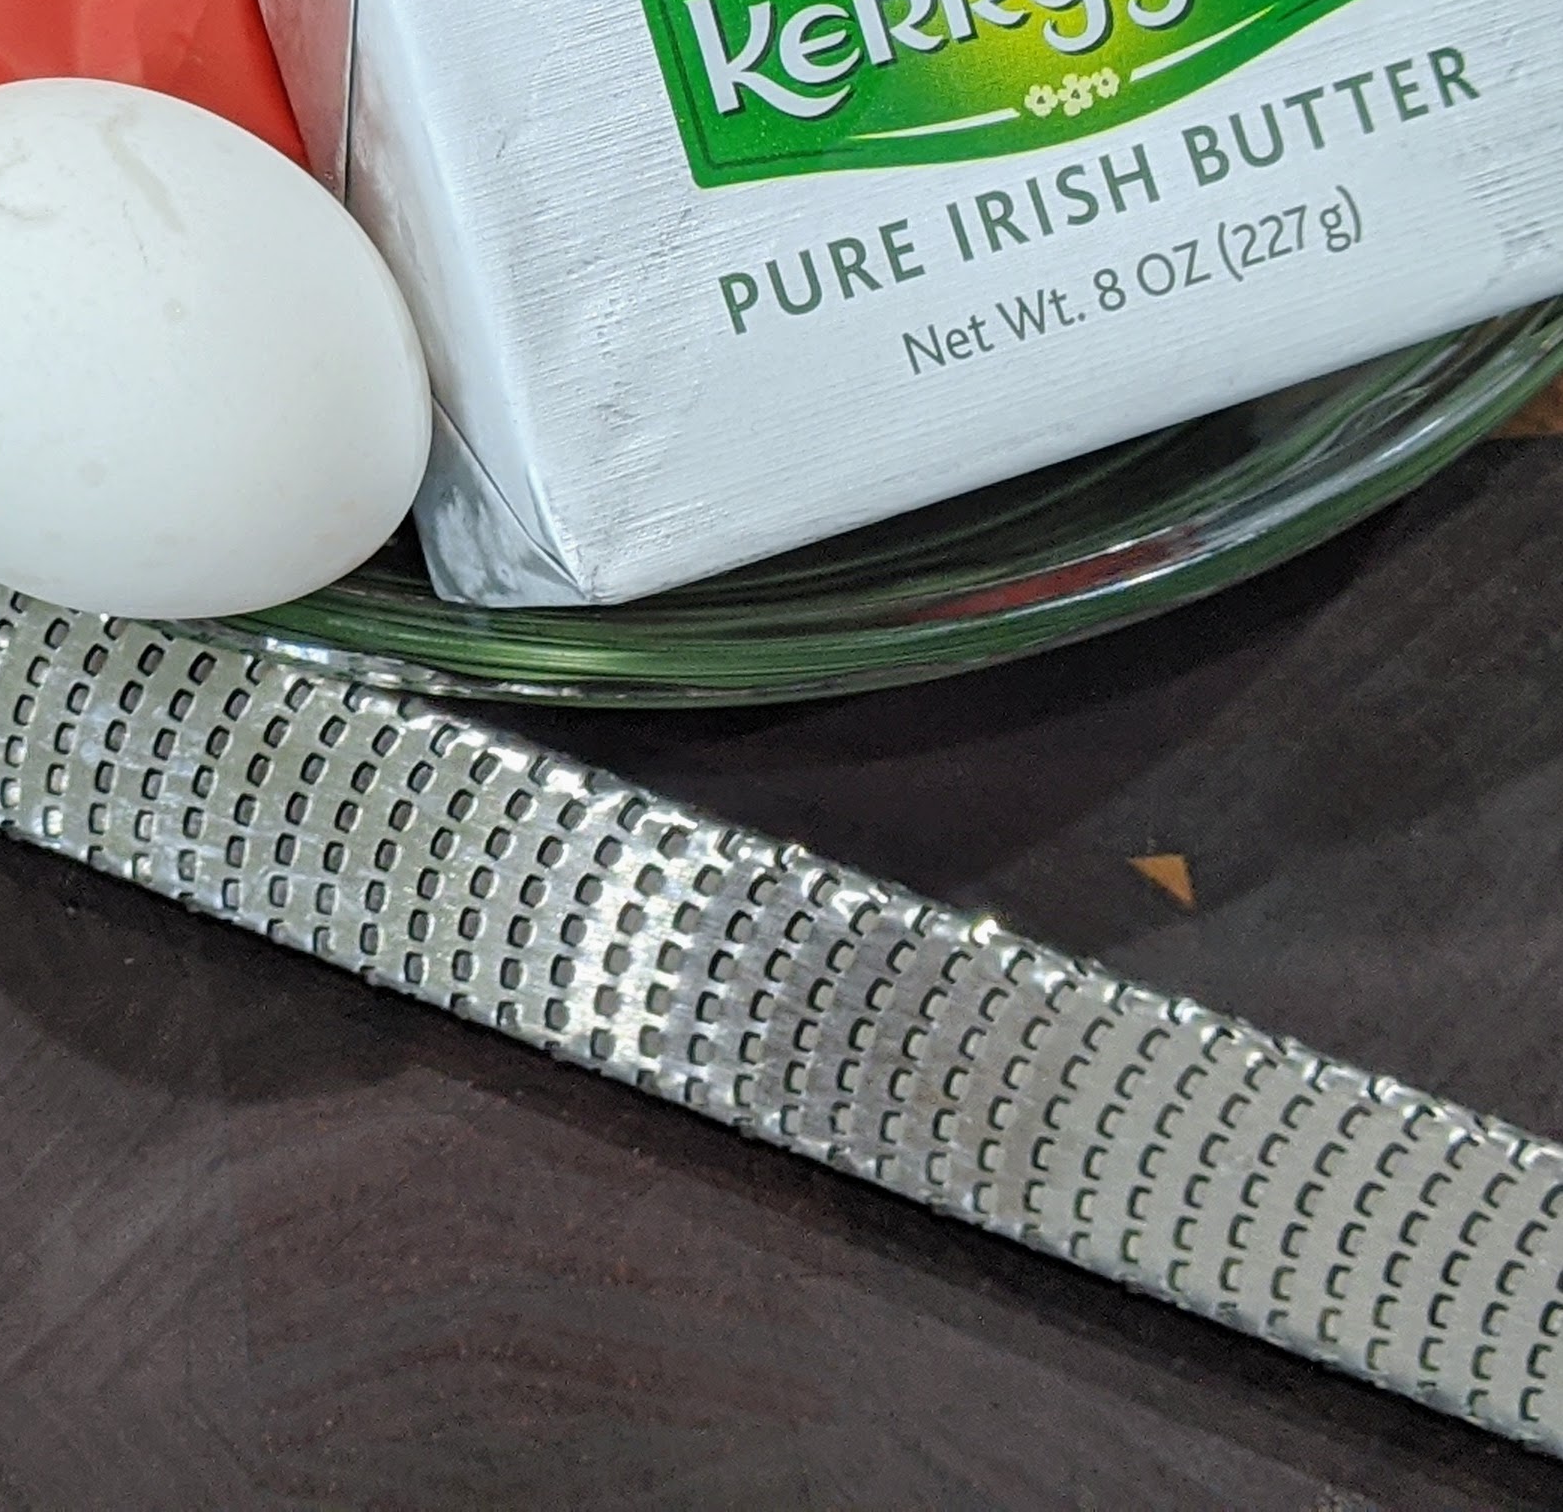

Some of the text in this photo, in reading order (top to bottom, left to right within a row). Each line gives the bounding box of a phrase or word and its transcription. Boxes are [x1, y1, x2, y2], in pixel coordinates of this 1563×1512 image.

[716, 44, 1483, 338] PURE IRISH BUTTER
[900, 313, 997, 378] Net
[995, 288, 1087, 336] Wt.
[1096, 267, 1128, 314] 8
[1134, 238, 1212, 299] OZ
